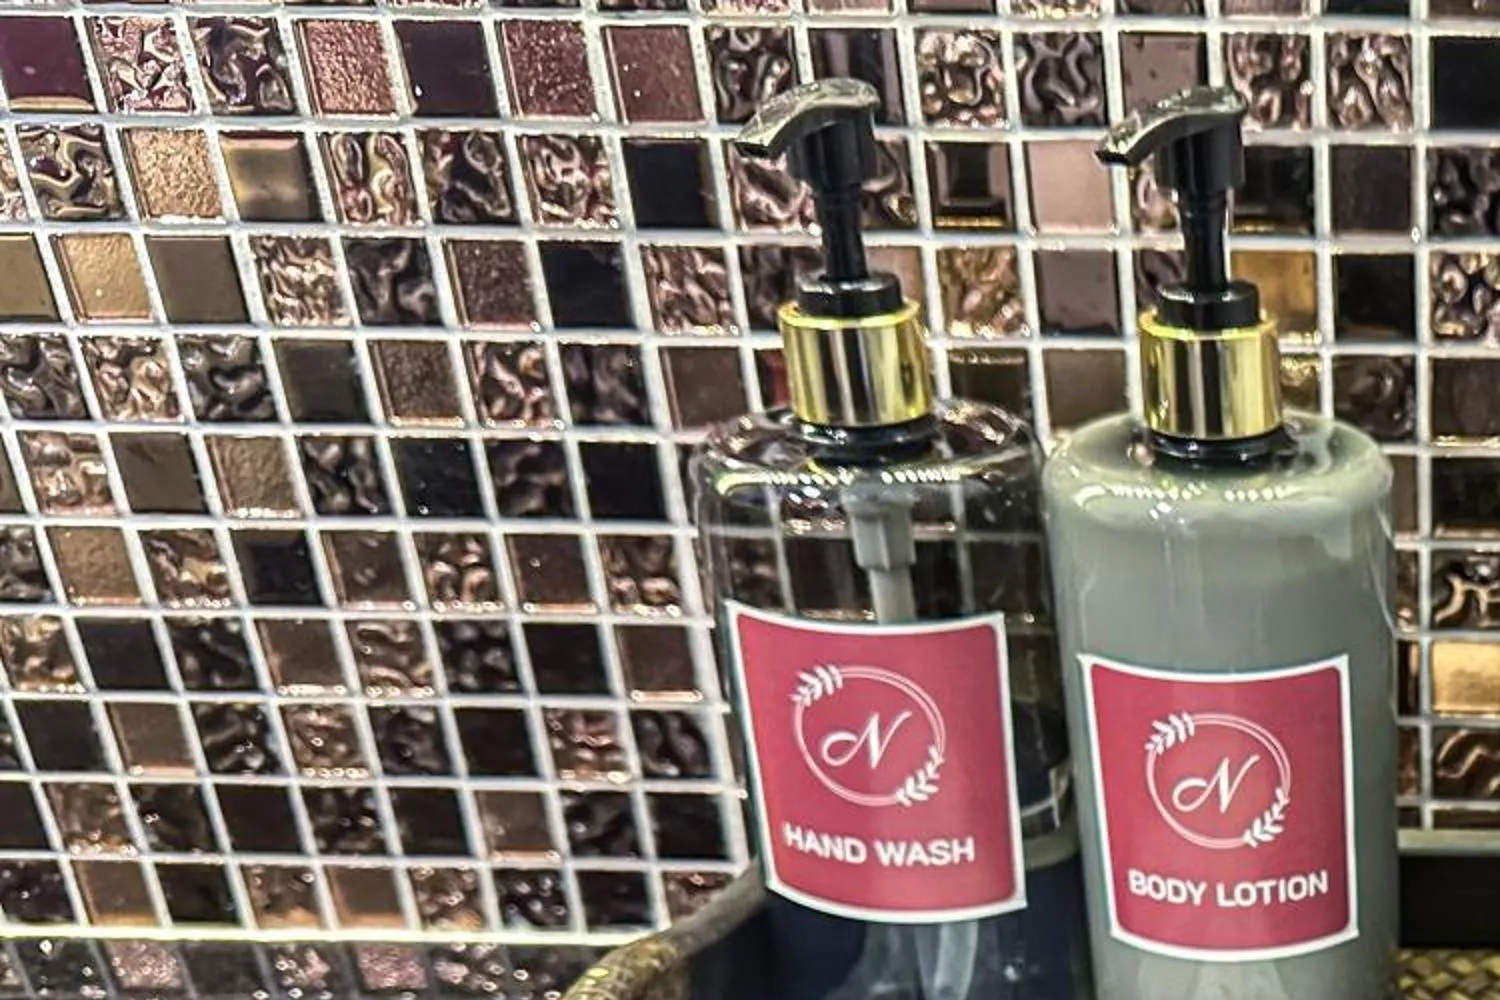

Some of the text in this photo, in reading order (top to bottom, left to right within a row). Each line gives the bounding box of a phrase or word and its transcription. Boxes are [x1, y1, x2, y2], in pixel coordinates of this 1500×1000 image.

[821, 711, 912, 769] N
[1172, 754, 1260, 814] N
[783, 821, 975, 867] HAND WASH
[1128, 868, 1328, 907] BODY LOTION
